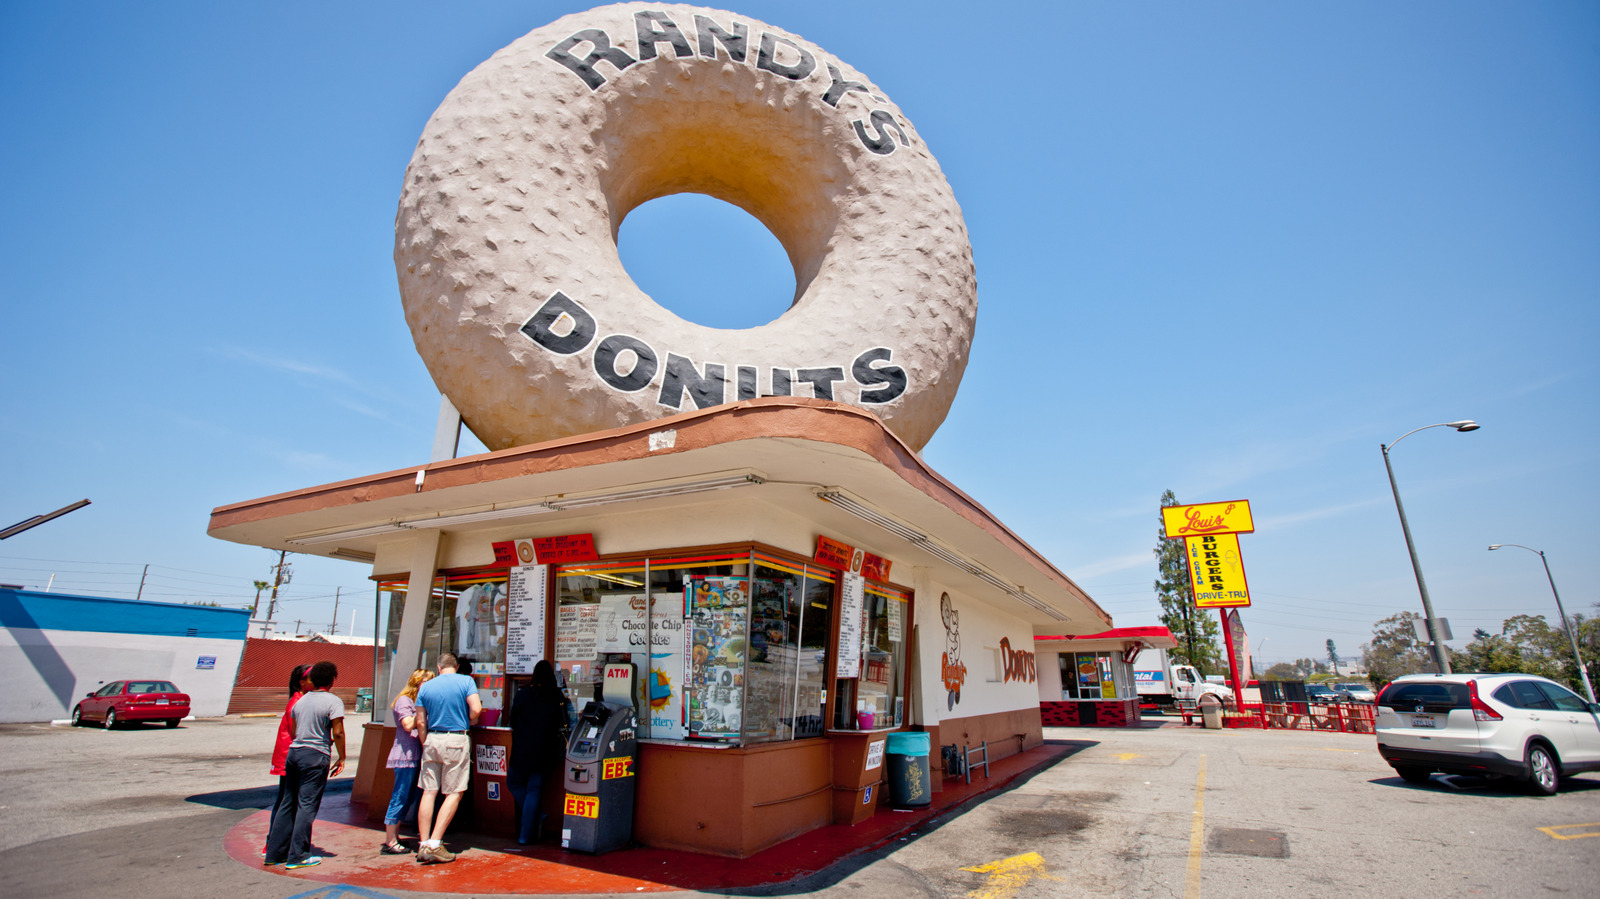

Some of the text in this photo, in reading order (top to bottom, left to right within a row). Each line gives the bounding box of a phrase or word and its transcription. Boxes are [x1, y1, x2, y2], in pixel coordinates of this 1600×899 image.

[543, 10, 910, 156] RANDY'S
[518, 289, 908, 410] DONUTS
[1178, 507, 1230, 533] Louis
[1202, 536, 1224, 590] BURGERS
[1194, 561, 1204, 585] CREAM
[1196, 591, 1247, 600] DRIVE-TRU
[622, 620, 682, 632] Chocote Chip
[629, 631, 670, 646] Cooies
[607, 668, 628, 678] ATM
[638, 717, 674, 730] caottery
[478, 760, 502, 772] WINDO
[566, 799, 596, 816] EBT
